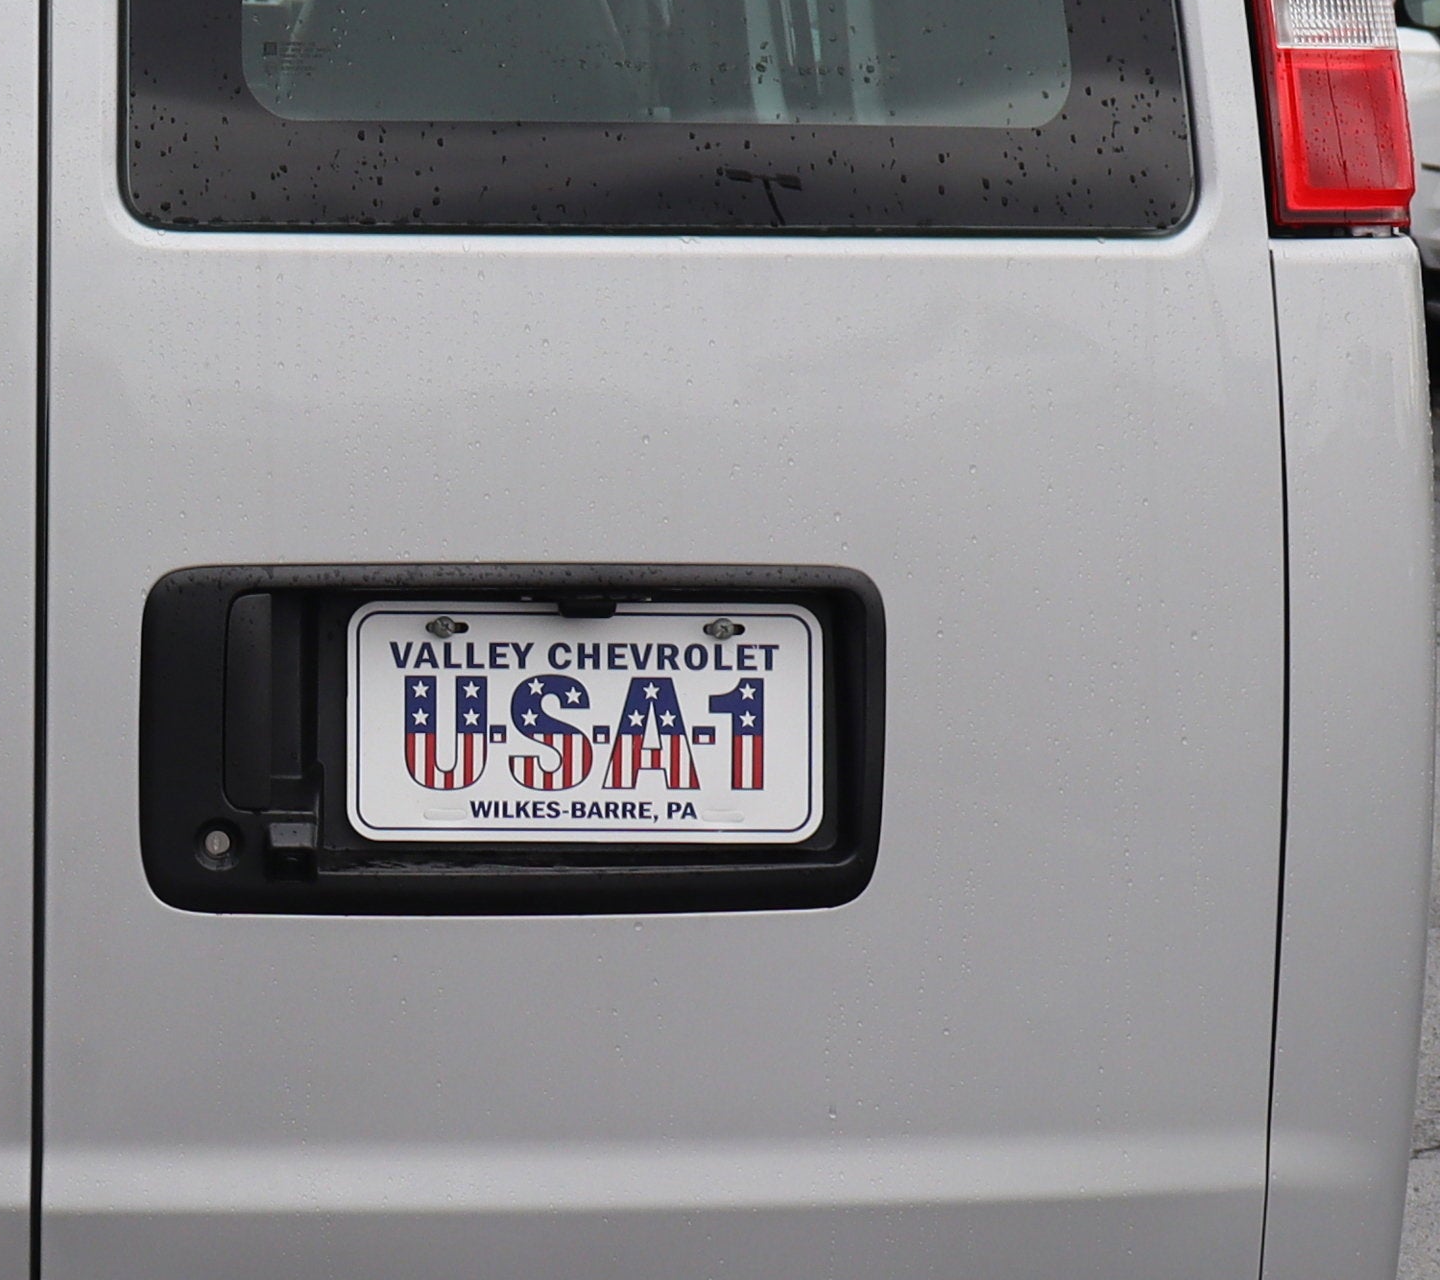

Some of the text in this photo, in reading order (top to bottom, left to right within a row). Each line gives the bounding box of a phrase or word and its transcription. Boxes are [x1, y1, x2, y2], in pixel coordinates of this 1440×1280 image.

[389, 641, 780, 672] VALLEY CHEVROLET
[470, 800, 698, 823] WILKES-BARRE, PA
